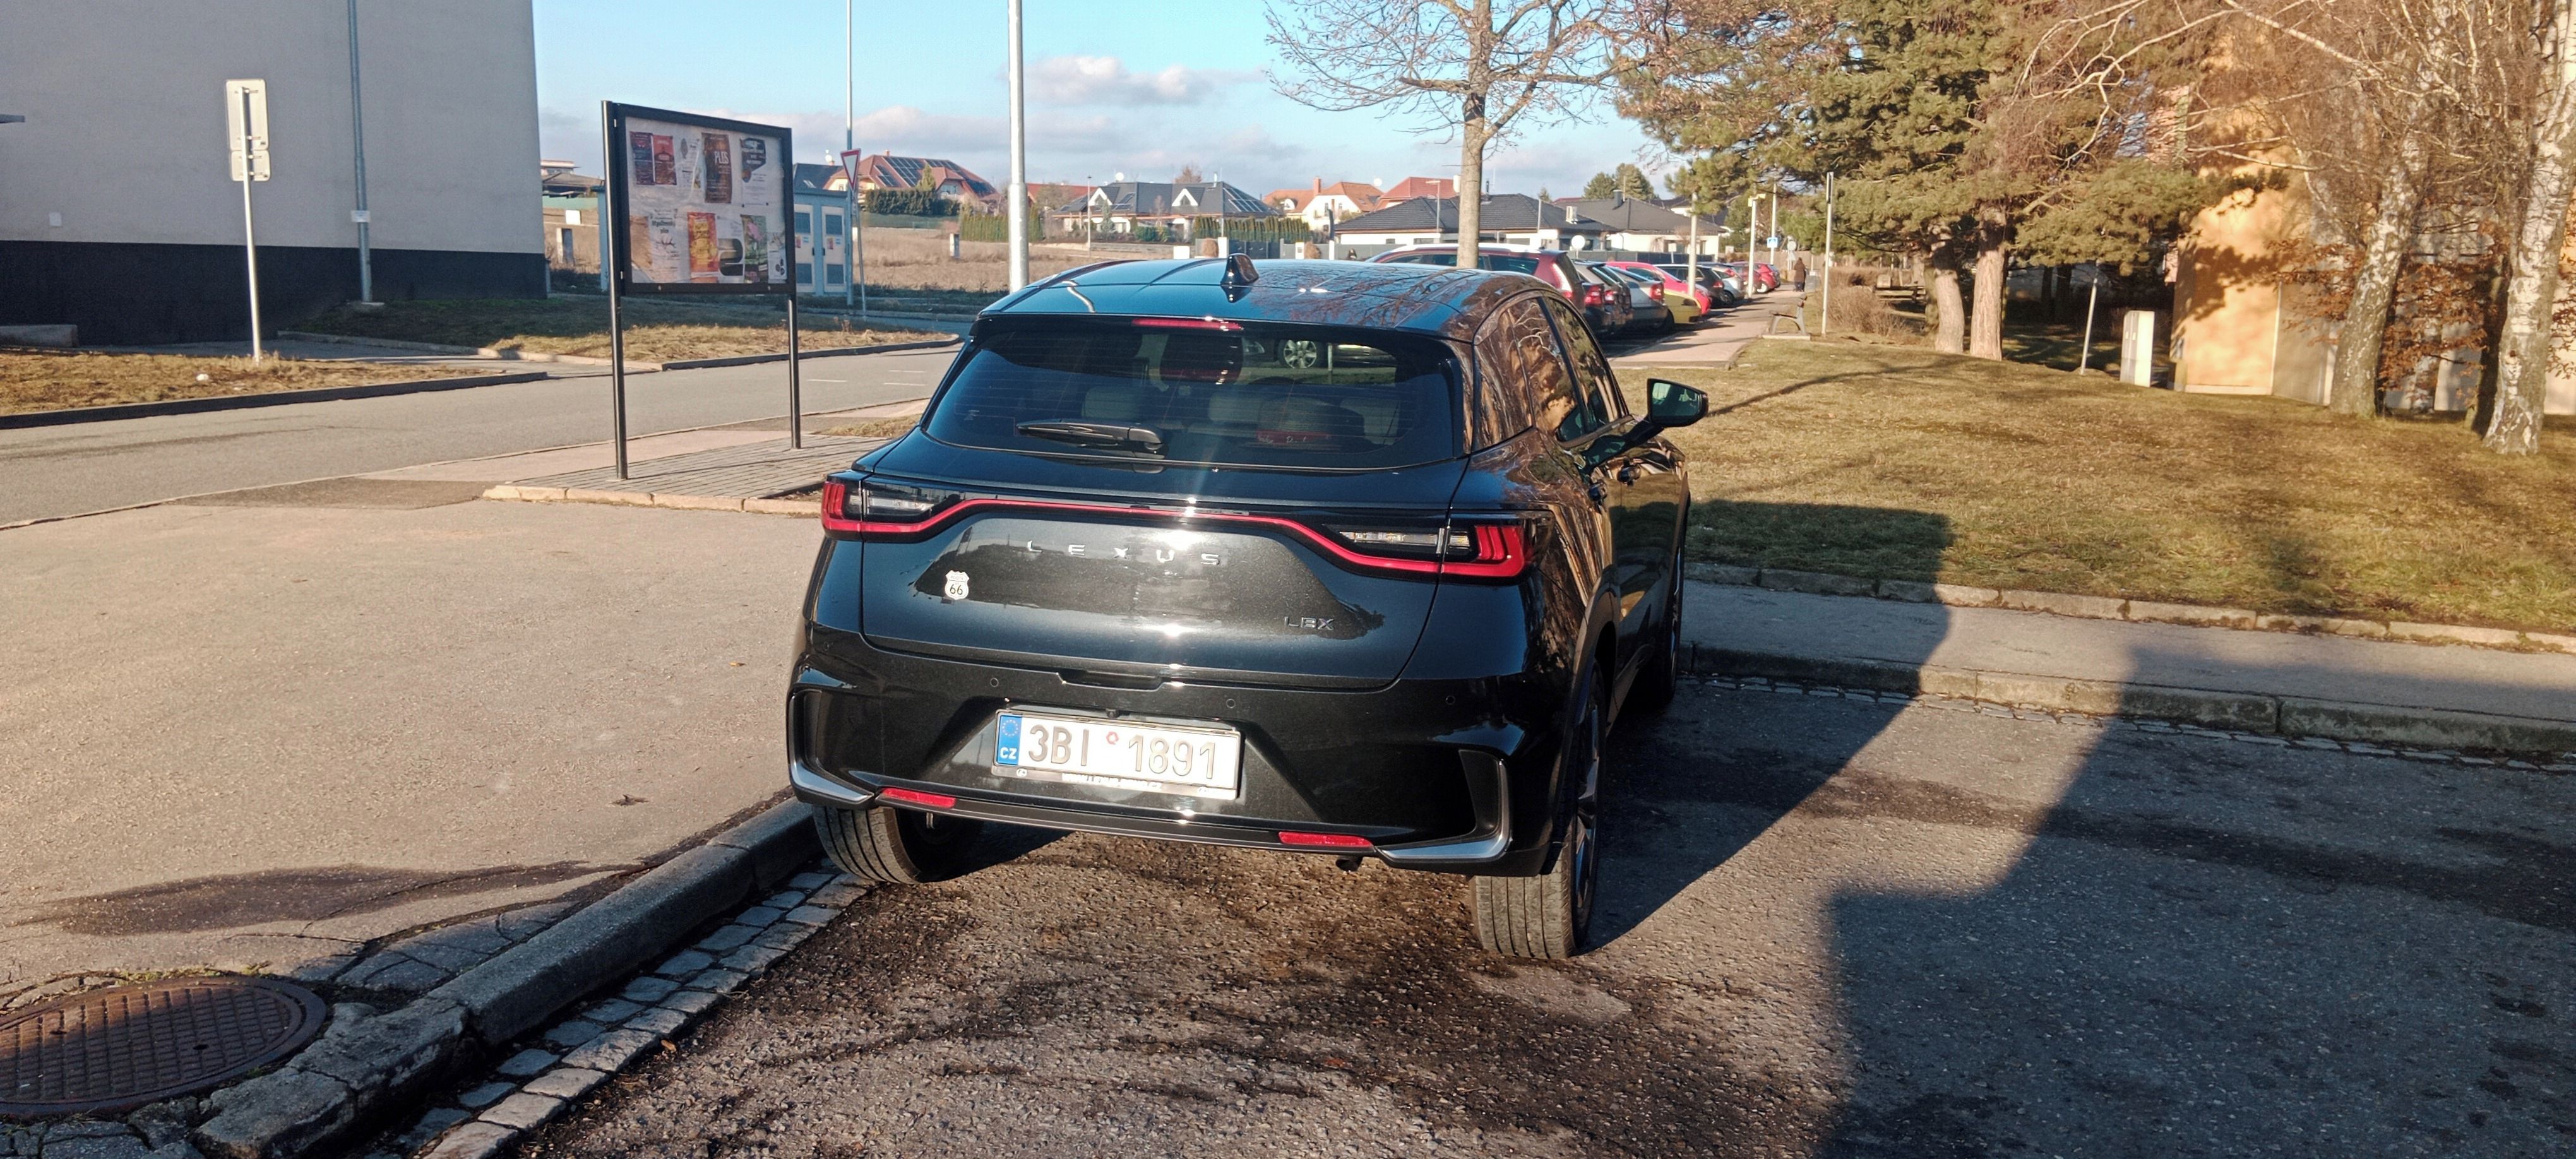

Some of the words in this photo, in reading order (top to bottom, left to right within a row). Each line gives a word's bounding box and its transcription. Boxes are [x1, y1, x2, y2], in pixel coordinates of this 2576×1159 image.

[1027, 540, 1220, 566] LEXUS
[950, 584, 963, 595] 66
[1284, 616, 1335, 631] LBX
[999, 746, 1017, 759] CZ
[1028, 724, 1090, 766] 3BI
[1128, 734, 1216, 780] 1891
